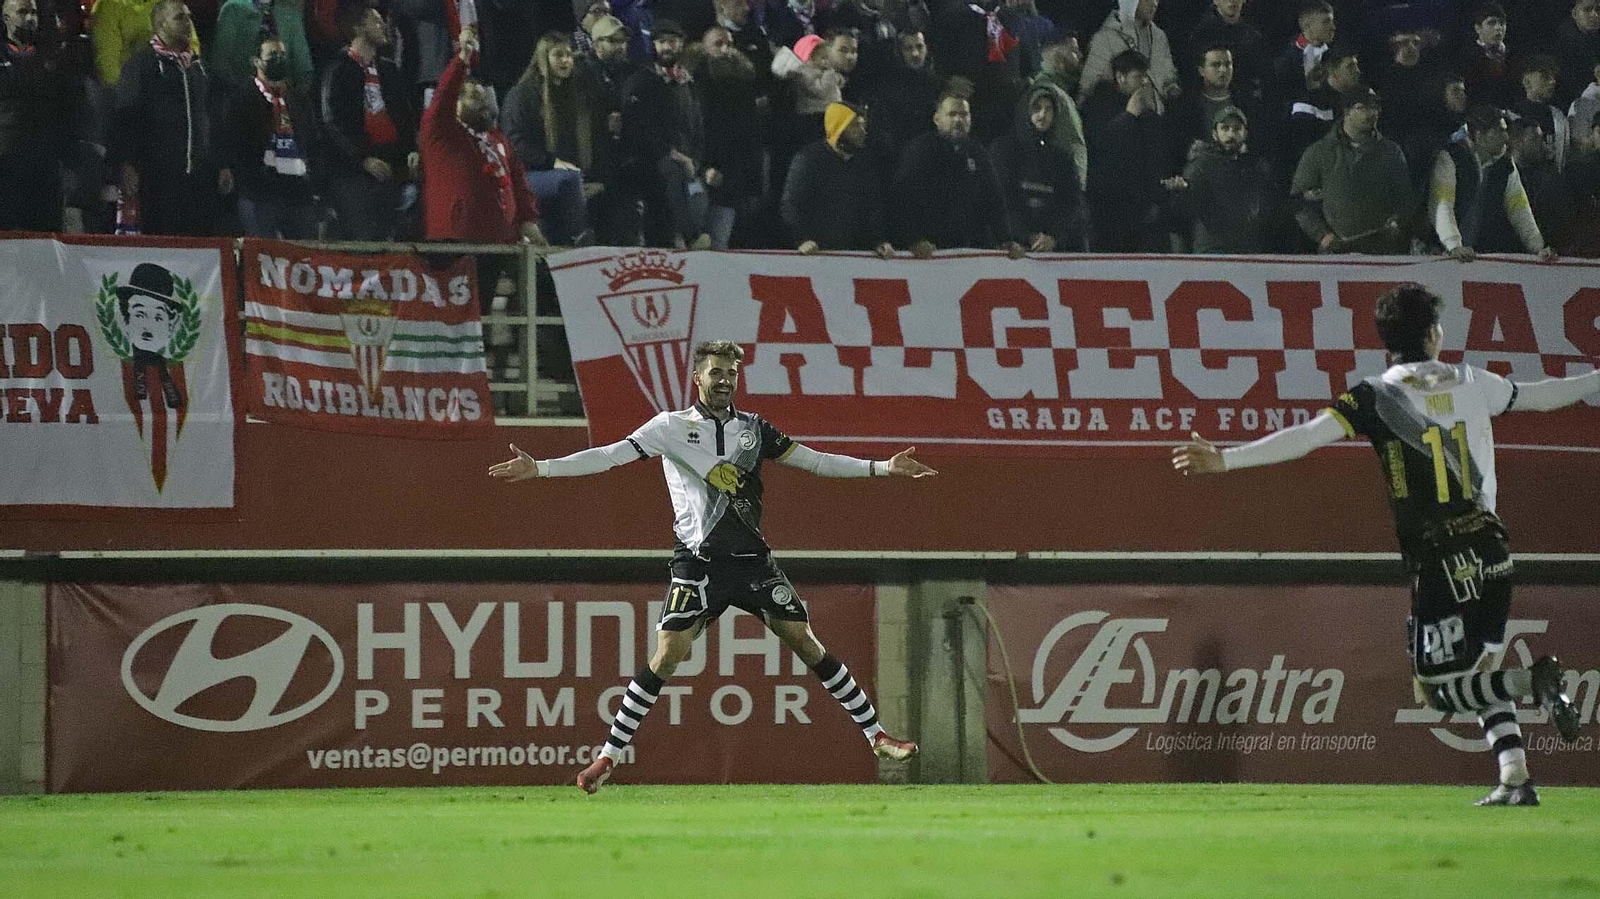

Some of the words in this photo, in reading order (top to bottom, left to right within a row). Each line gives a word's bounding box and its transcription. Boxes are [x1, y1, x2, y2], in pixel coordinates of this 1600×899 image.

[258, 253, 471, 307] NÓMADAS
[0, 388, 99, 424] EVA
[262, 372, 481, 422] ROJIBLANCOS
[987, 407, 1109, 431] GRADA
[1130, 407, 1197, 430] ACF
[1422, 421, 1473, 503] 11
[670, 586, 694, 611] 17
[354, 684, 812, 730] PERMOTOR
[307, 743, 635, 774] ventas@permotor.cm
[1146, 732, 1213, 754] Logística
[1217, 732, 1274, 754] Integral
[1277, 736, 1296, 751] en
[1300, 733, 1377, 754] transporte
